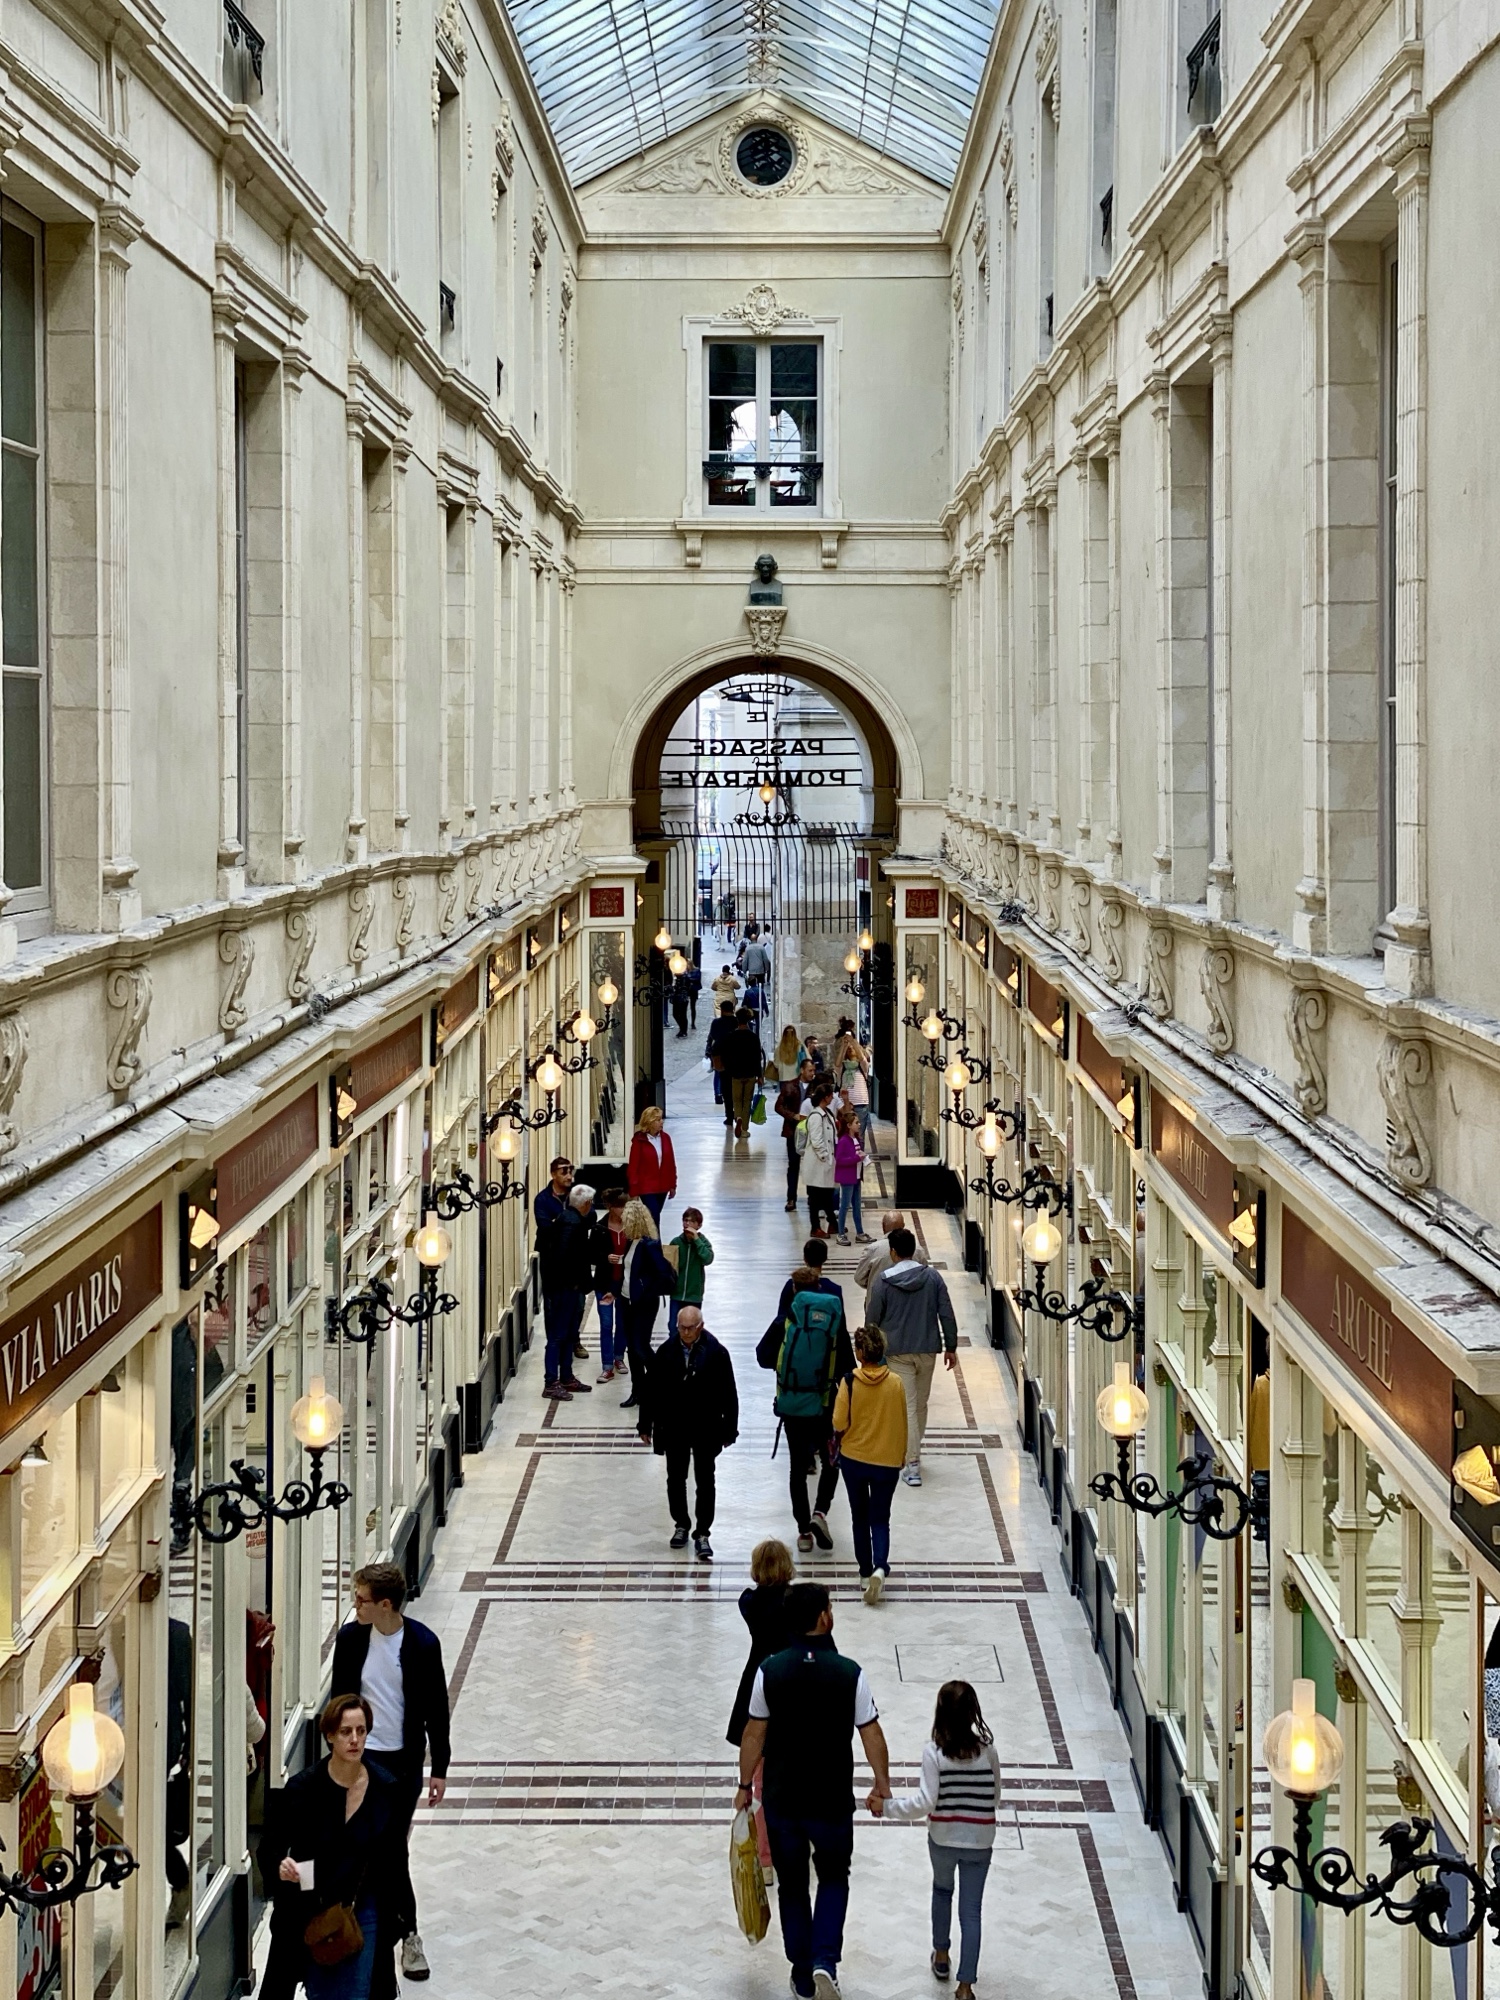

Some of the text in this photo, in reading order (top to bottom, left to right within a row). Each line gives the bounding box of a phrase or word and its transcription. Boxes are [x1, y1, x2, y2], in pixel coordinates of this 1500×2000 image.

[232, 1113, 303, 1206] PHOTOMATON
[1177, 1127, 1209, 1199] ARCHE
[1, 1254, 123, 1405] VIA MARIS
[1330, 1273, 1393, 1391] ARCHE
